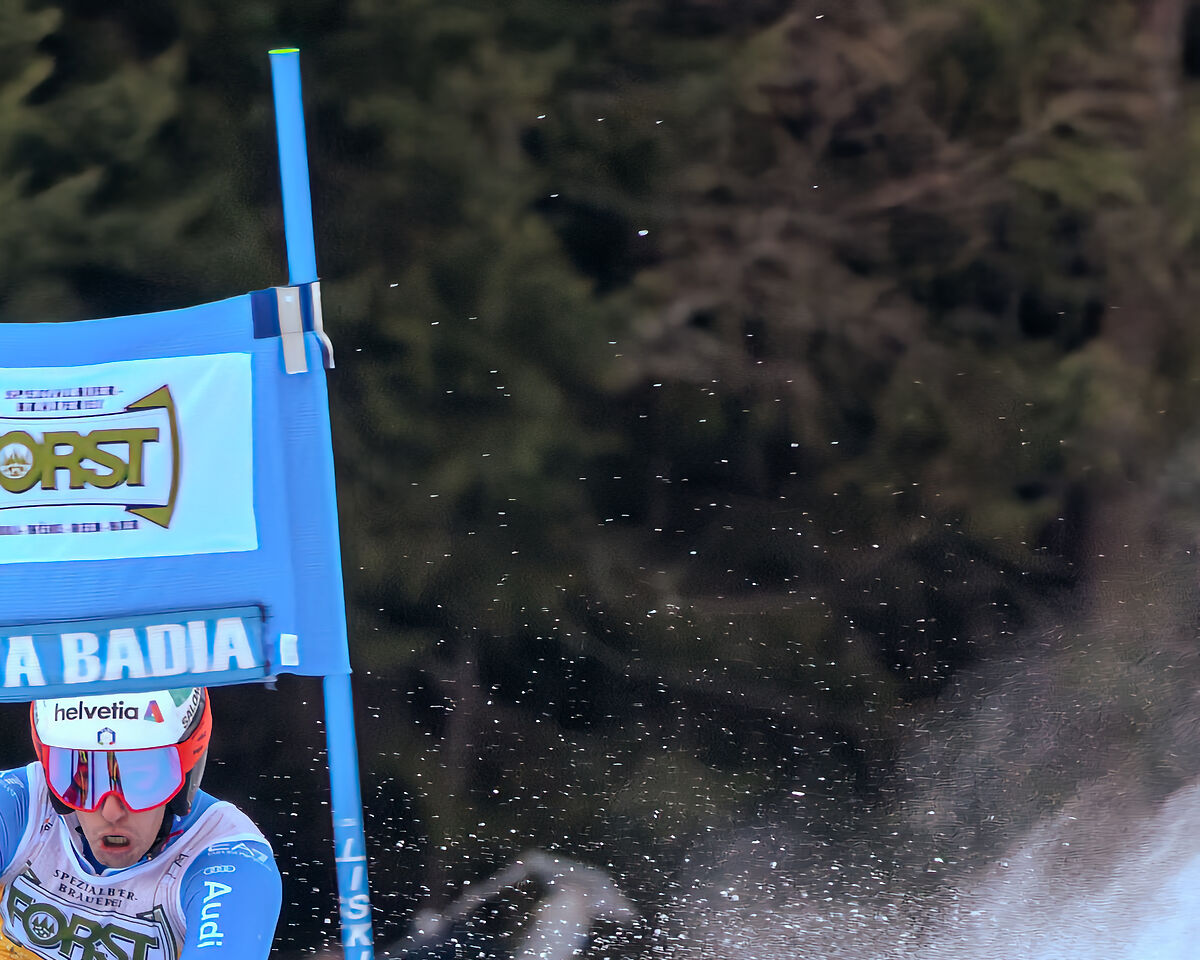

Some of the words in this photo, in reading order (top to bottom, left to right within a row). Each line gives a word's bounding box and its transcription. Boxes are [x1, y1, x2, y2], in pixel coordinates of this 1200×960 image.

[59, 616, 256, 685] BADIA
[53, 700, 140, 722] helvetia
[197, 881, 232, 948] Audi
